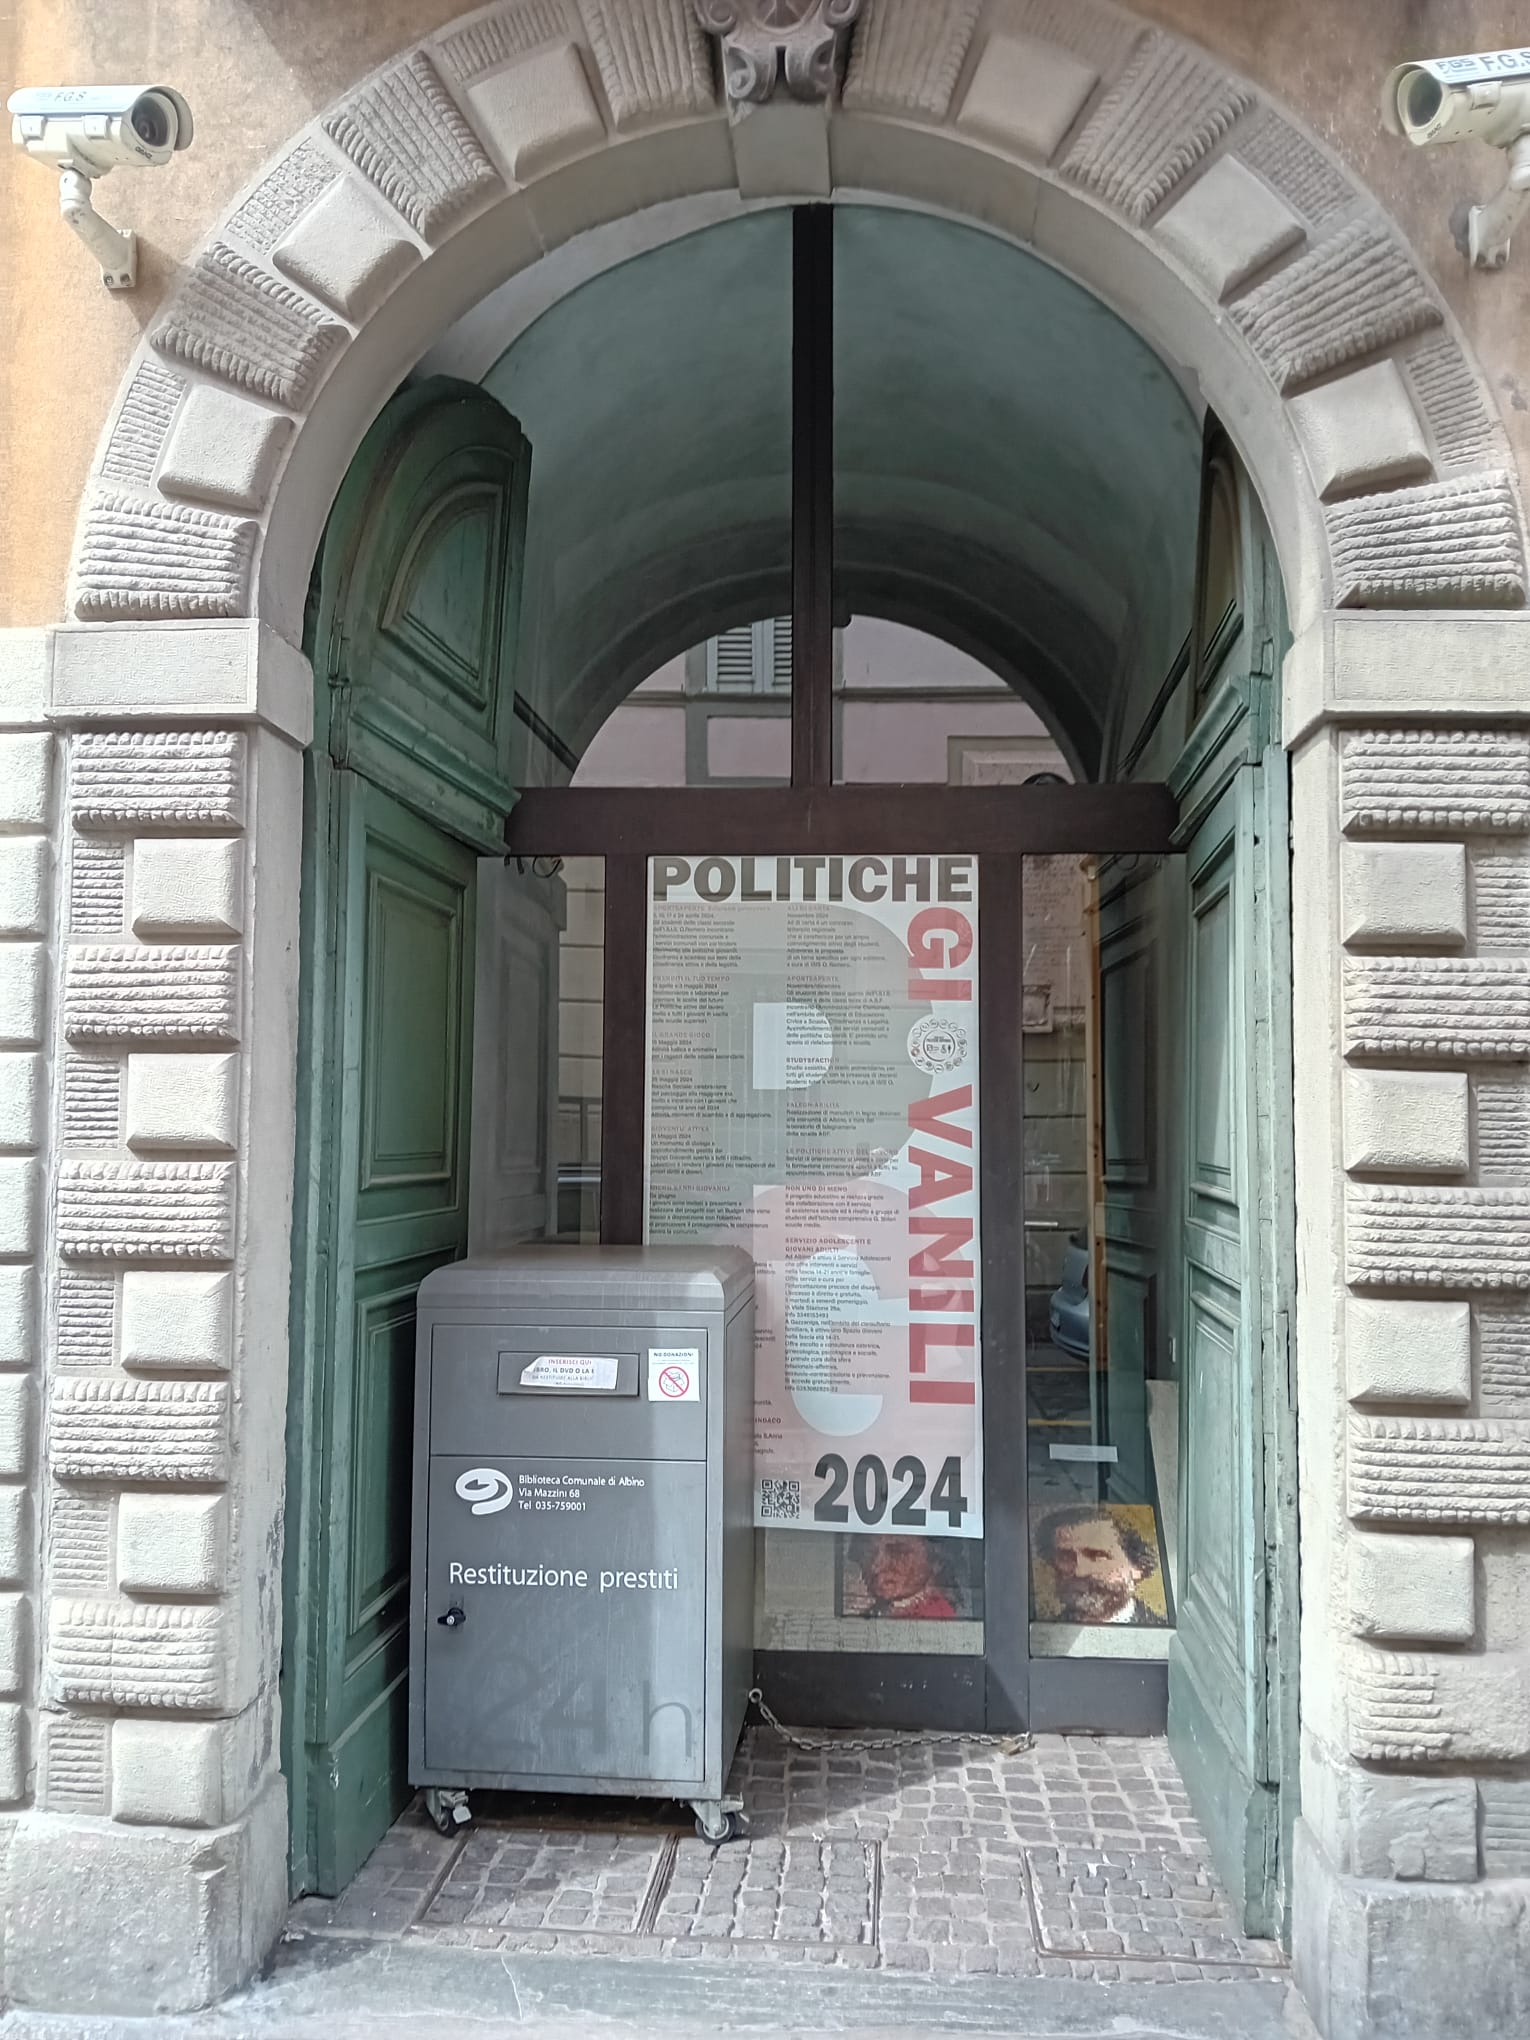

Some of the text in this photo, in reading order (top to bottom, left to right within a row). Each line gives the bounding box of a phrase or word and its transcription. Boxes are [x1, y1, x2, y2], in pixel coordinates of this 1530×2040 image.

[653, 857, 973, 902] POLITICHE
[519, 1475, 645, 1487] Biblioteca Comunale di Albino
[814, 1453, 968, 1528] 2024
[519, 1488, 580, 1498] Via Mazzini 68
[518, 1501, 586, 1511] Tel 035-759001
[450, 1562, 678, 1593] Restituzione prestiti
